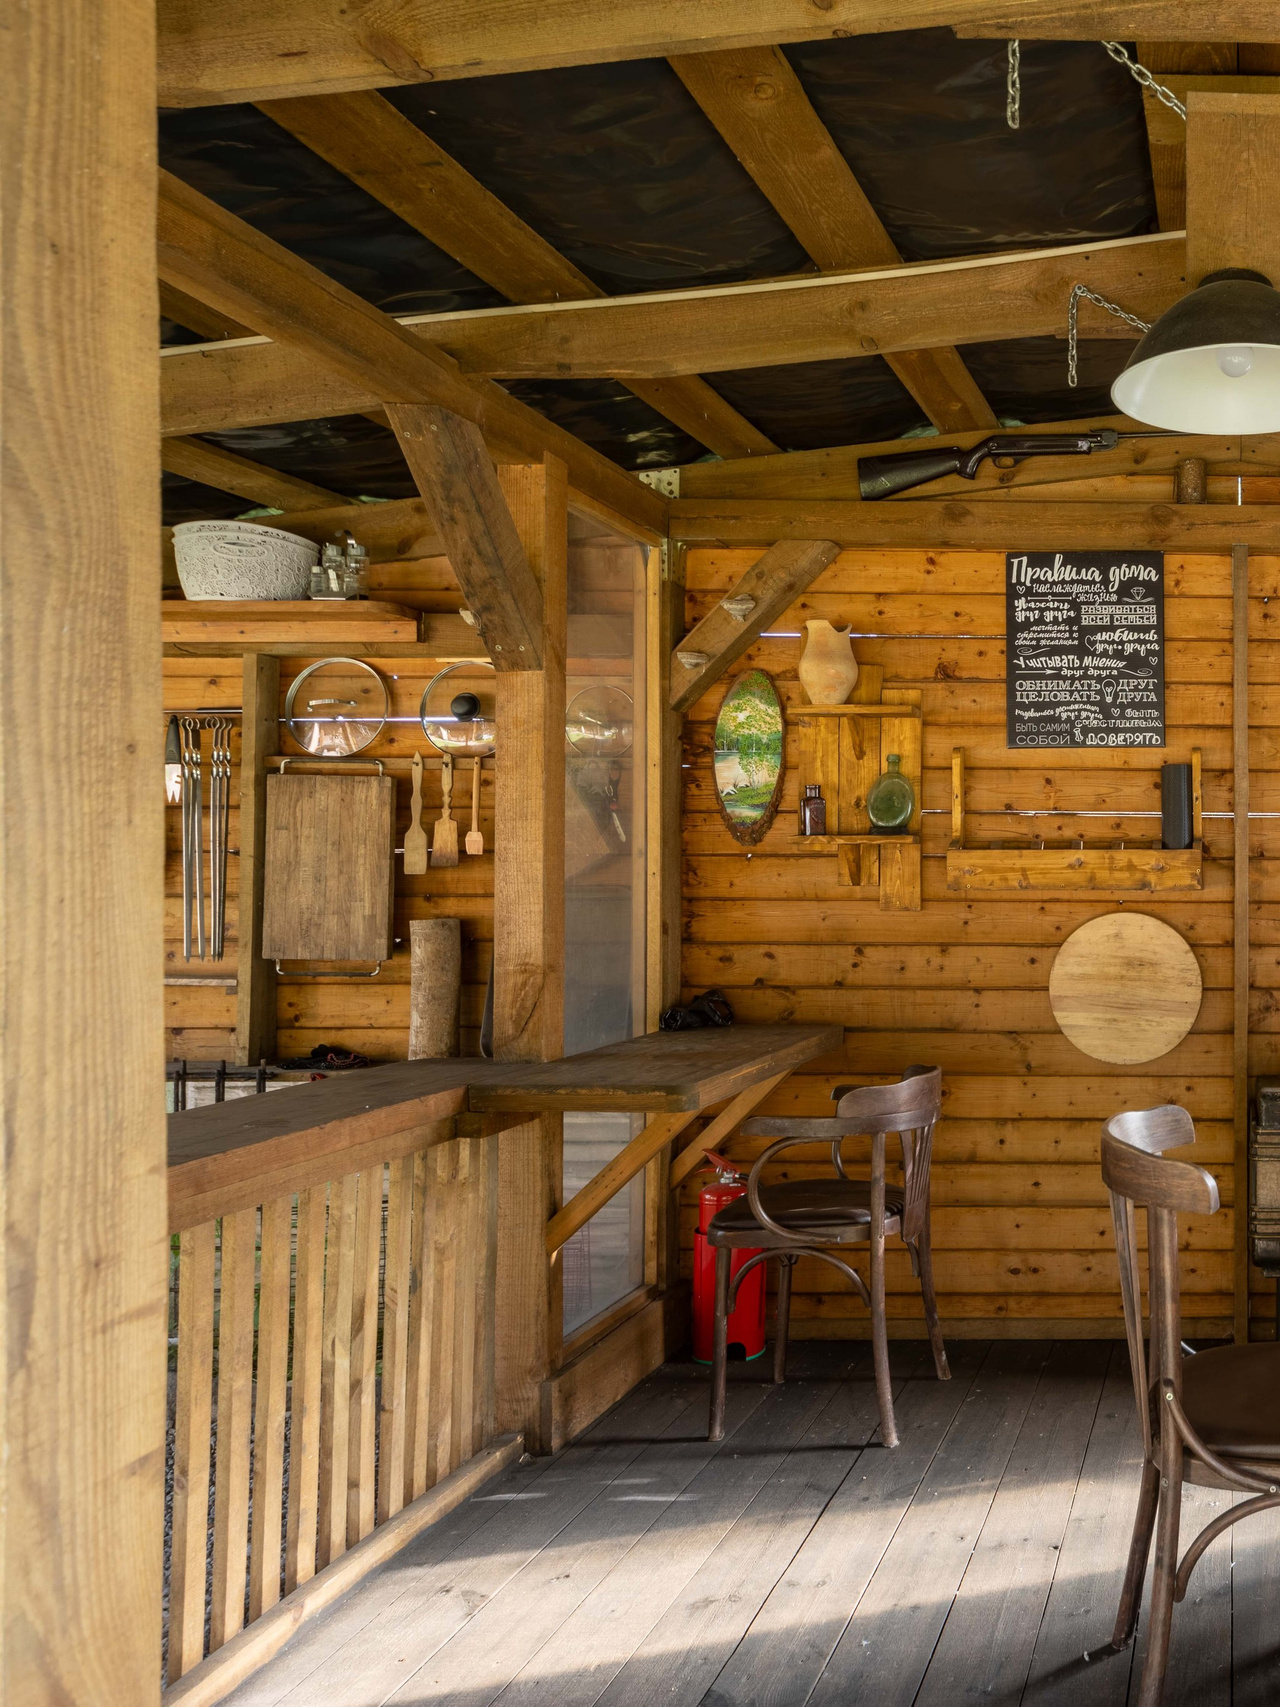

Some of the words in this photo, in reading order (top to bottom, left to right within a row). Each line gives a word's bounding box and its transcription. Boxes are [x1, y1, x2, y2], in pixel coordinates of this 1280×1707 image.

[1011, 554, 1103, 586] Правила
[1109, 564, 1159, 592] дома
[1077, 593, 1118, 606] жизнью
[1081, 605, 1156, 614] РАЗВИВАТЬСЯ
[1015, 610, 1040, 622] друг
[1043, 611, 1076, 622] друга
[1081, 615, 1110, 625] ВСЕЙ
[1113, 615, 1157, 625] СЕМЬЕЙ
[1015, 636, 1036, 645] своим
[1096, 628, 1158, 641] любить
[1124, 643, 1159, 656] друга
[1061, 668, 1084, 676] друг
[1087, 668, 1118, 677] друга
[1016, 680, 1100, 690] ОБНИМАТЬ
[1117, 679, 1158, 691] ДРУГ
[1016, 691, 1100, 704] ЦЕЛОВАТЬ
[1117, 692, 1158, 704] ДРУГА
[1016, 724, 1037, 732] БЫТЬ
[1040, 723, 1070, 732] САМИМ
[1016, 734, 1070, 745] СОБОЙ
[1086, 733, 1160, 745] ДОВЕРЯТЬ
